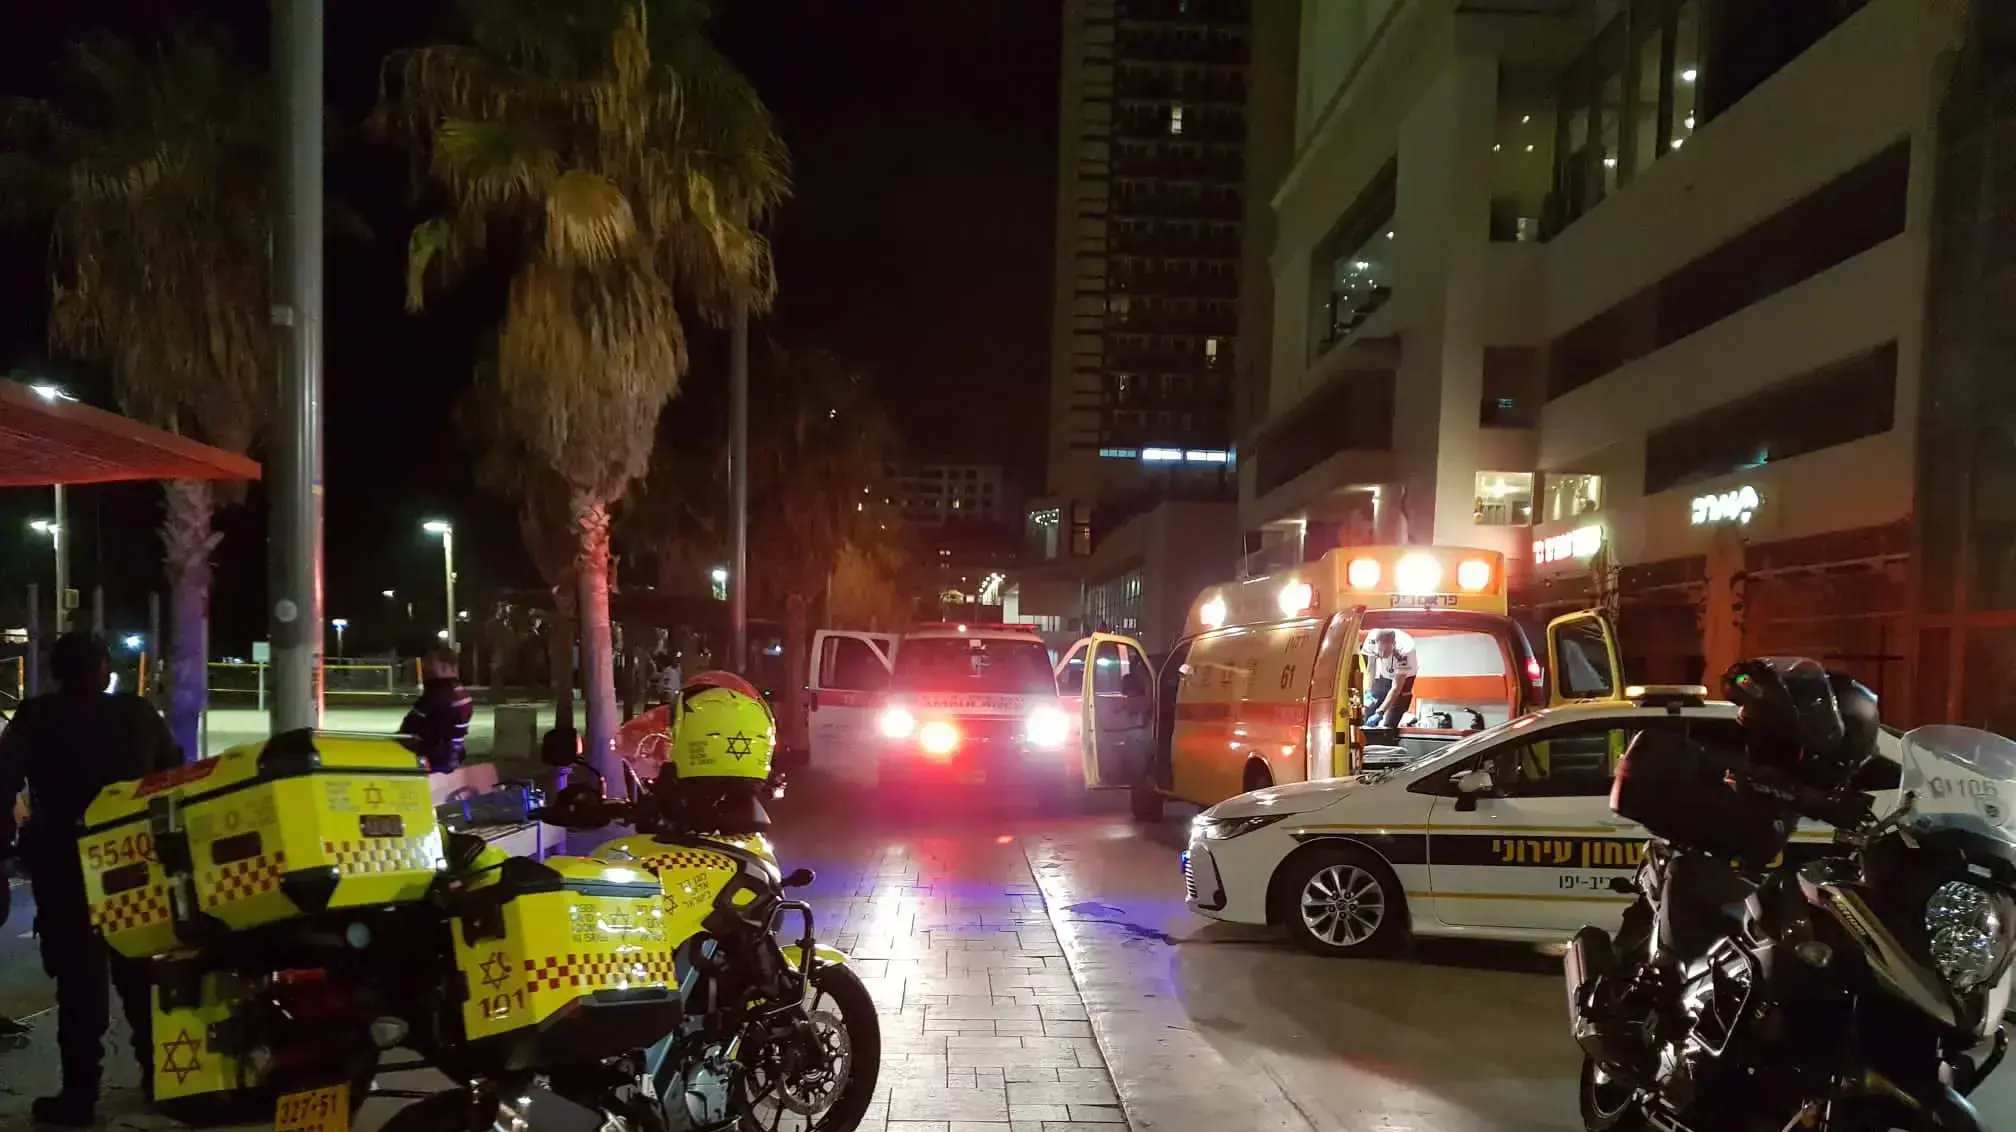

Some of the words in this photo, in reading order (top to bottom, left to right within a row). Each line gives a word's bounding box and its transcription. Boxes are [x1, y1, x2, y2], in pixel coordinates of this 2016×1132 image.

[1280, 663, 1296, 689] 61
[1491, 839, 1573, 864] עירוני
[477, 988, 525, 1019] 101
